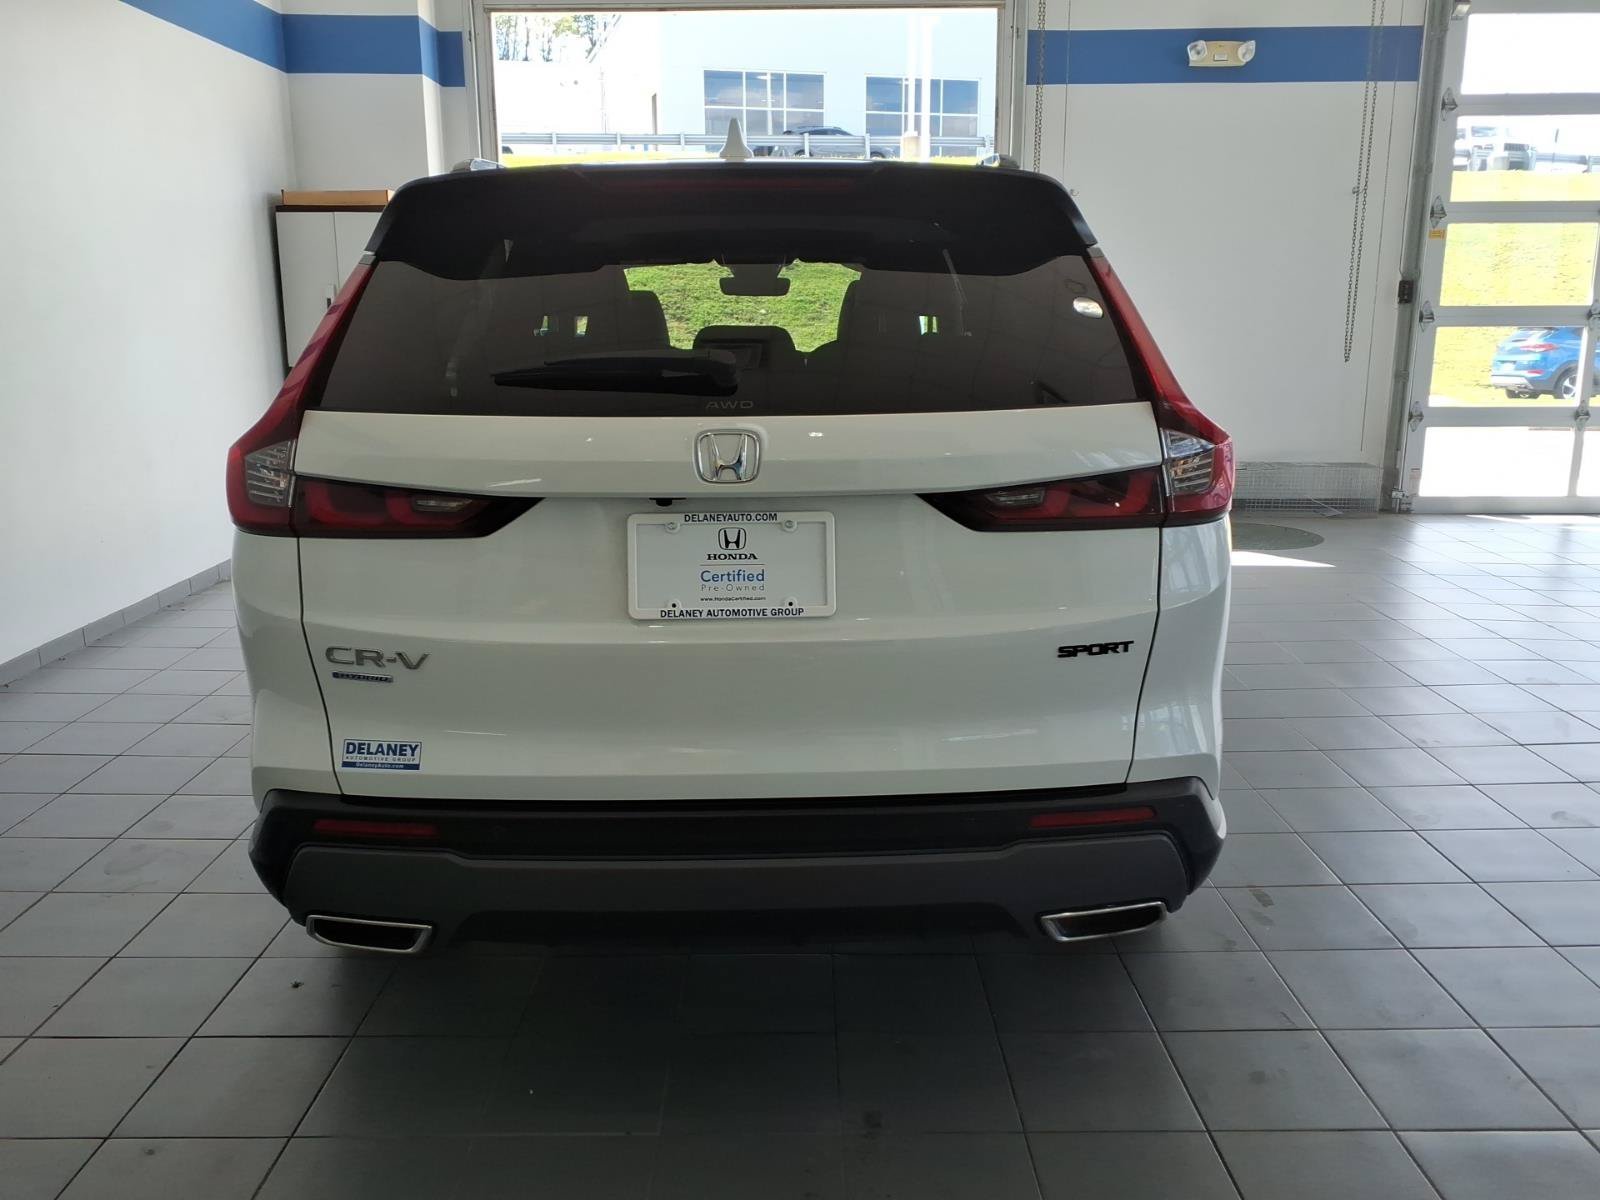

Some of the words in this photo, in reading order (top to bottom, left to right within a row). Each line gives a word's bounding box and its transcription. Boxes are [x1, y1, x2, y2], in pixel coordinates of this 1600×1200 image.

[705, 400, 754, 409] AWD
[684, 513, 777, 523] DELANEYAUTO.COM
[706, 553, 758, 561] HONDA
[700, 569, 765, 582] Certified
[660, 609, 704, 618] DELANEY
[706, 609, 768, 618] AUTOMOTIVE
[770, 607, 804, 617] GROUP
[1057, 640, 1134, 658] SPORT
[325, 646, 431, 670] CR-V
[346, 742, 419, 757] DELANEY
